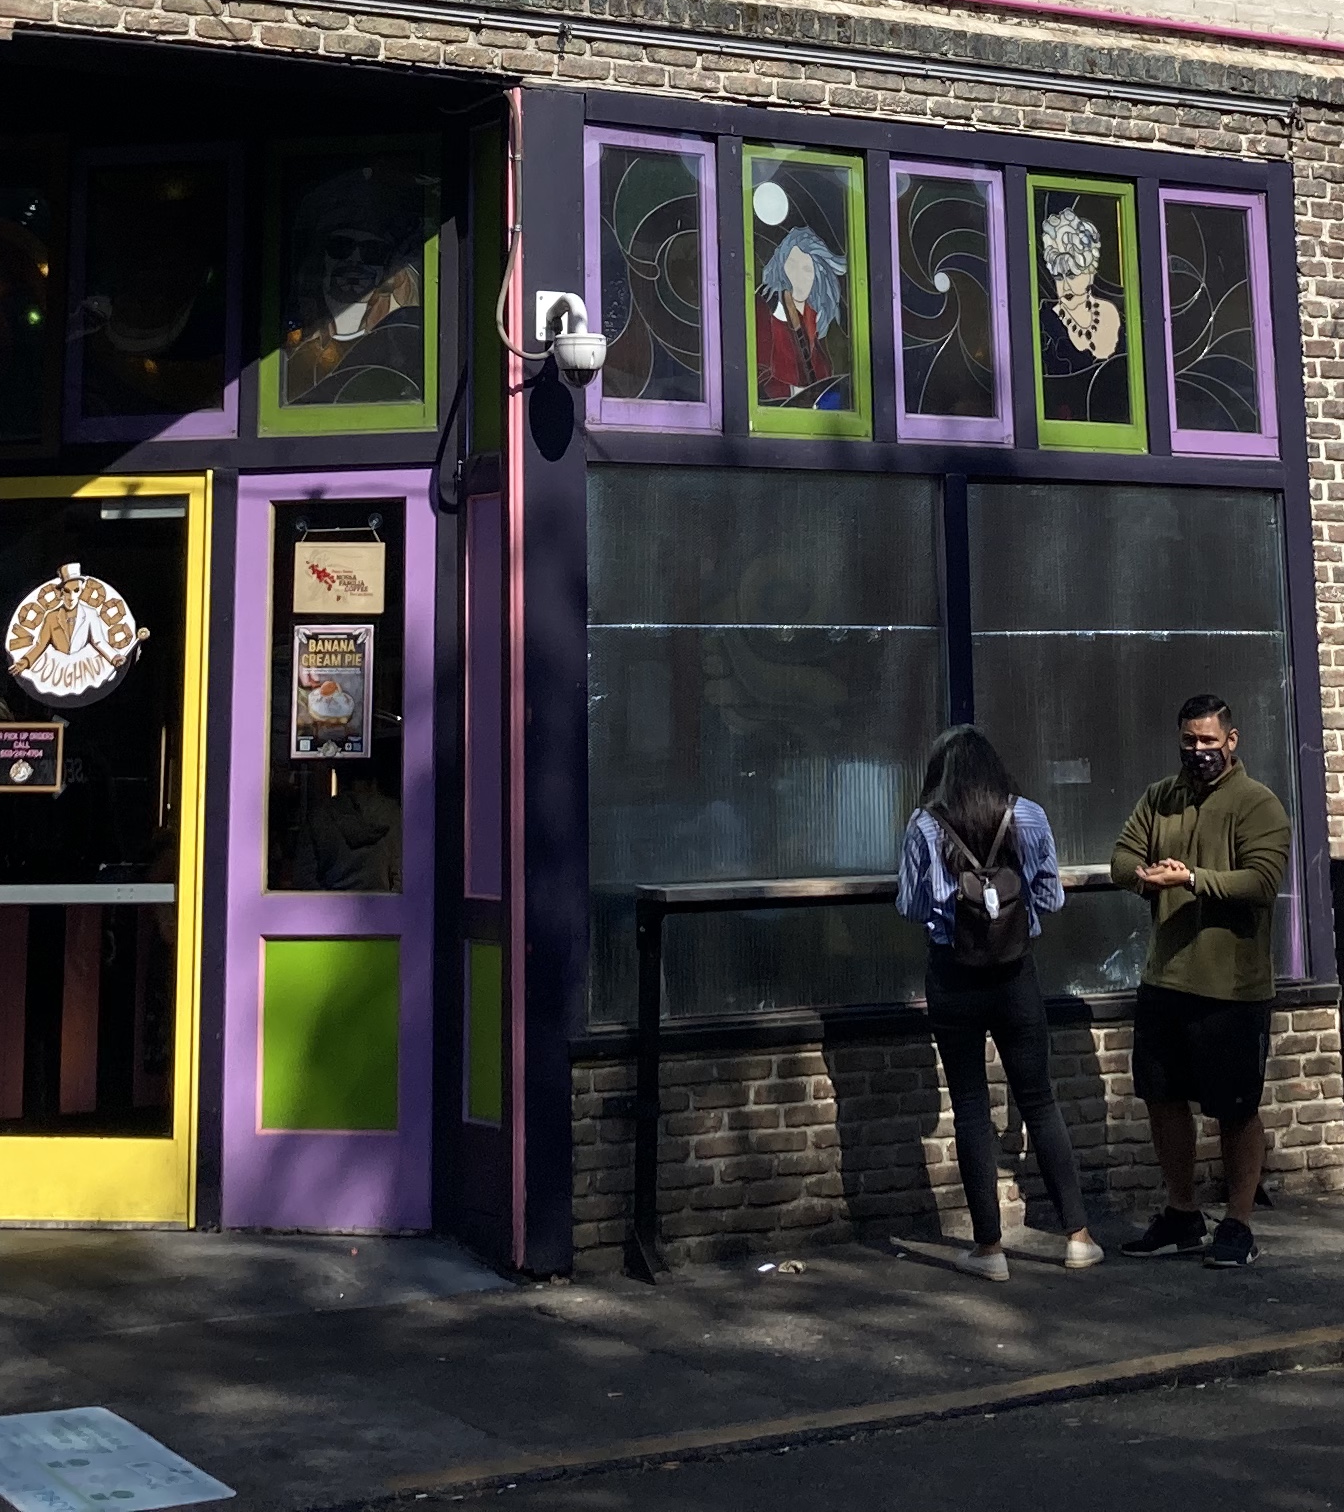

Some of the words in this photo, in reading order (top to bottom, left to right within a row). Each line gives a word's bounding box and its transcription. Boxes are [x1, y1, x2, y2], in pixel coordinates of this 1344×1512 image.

[9, 577, 134, 652] VOODOO
[308, 639, 356, 652] BANANA
[301, 653, 341, 667] CREAM
[344, 653, 363, 667] PIE
[31, 652, 106, 690] DOUGHNUT
[19, 732, 29, 741] UP
[13, 741, 30, 749] CALL
